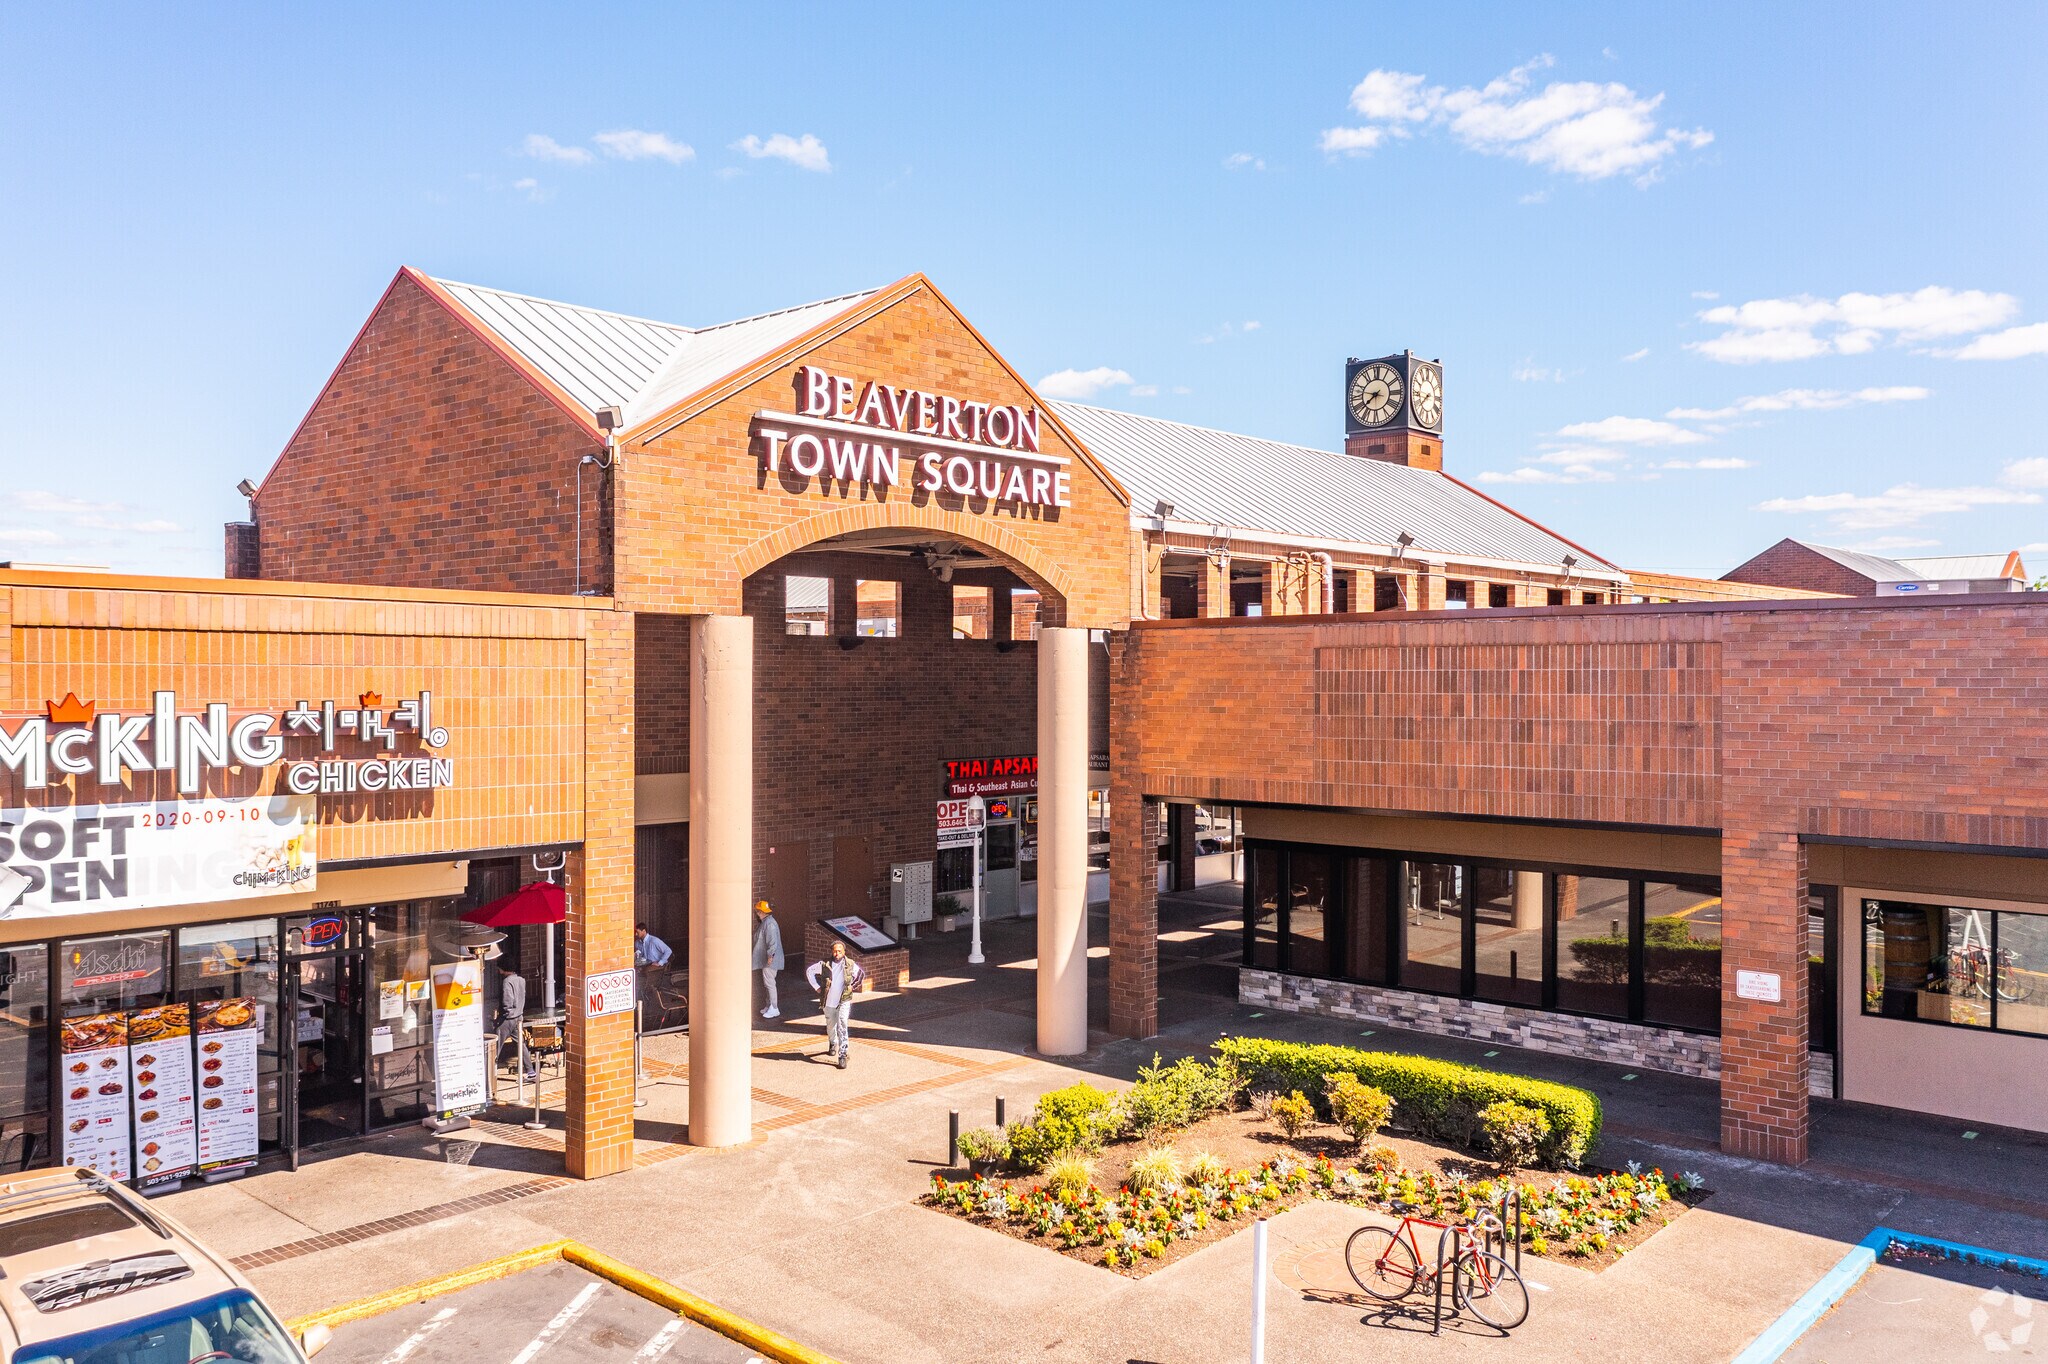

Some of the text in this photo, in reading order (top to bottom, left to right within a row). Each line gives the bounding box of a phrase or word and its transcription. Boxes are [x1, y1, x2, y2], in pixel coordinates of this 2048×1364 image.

[798, 365, 1040, 453] BEAVERTON
[755, 428, 1071, 508] TOWN SQUARE
[287, 758, 454, 795] CHICKEN
[946, 756, 1038, 780] THAI APSAR
[951, 783, 968, 794] Thai
[968, 783, 975, 793] &
[976, 781, 1008, 792] Southeast
[1010, 779, 1029, 789] Asian
[142, 808, 260, 828] 2020-09-10
[937, 801, 967, 818] OPE
[991, 804, 1007, 813] OPEN
[302, 919, 342, 942] OPEN
[75, 944, 146, 977] Asahi
[590, 993, 603, 1013] NO
[146, 1169, 191, 1186] 503-941-9299
